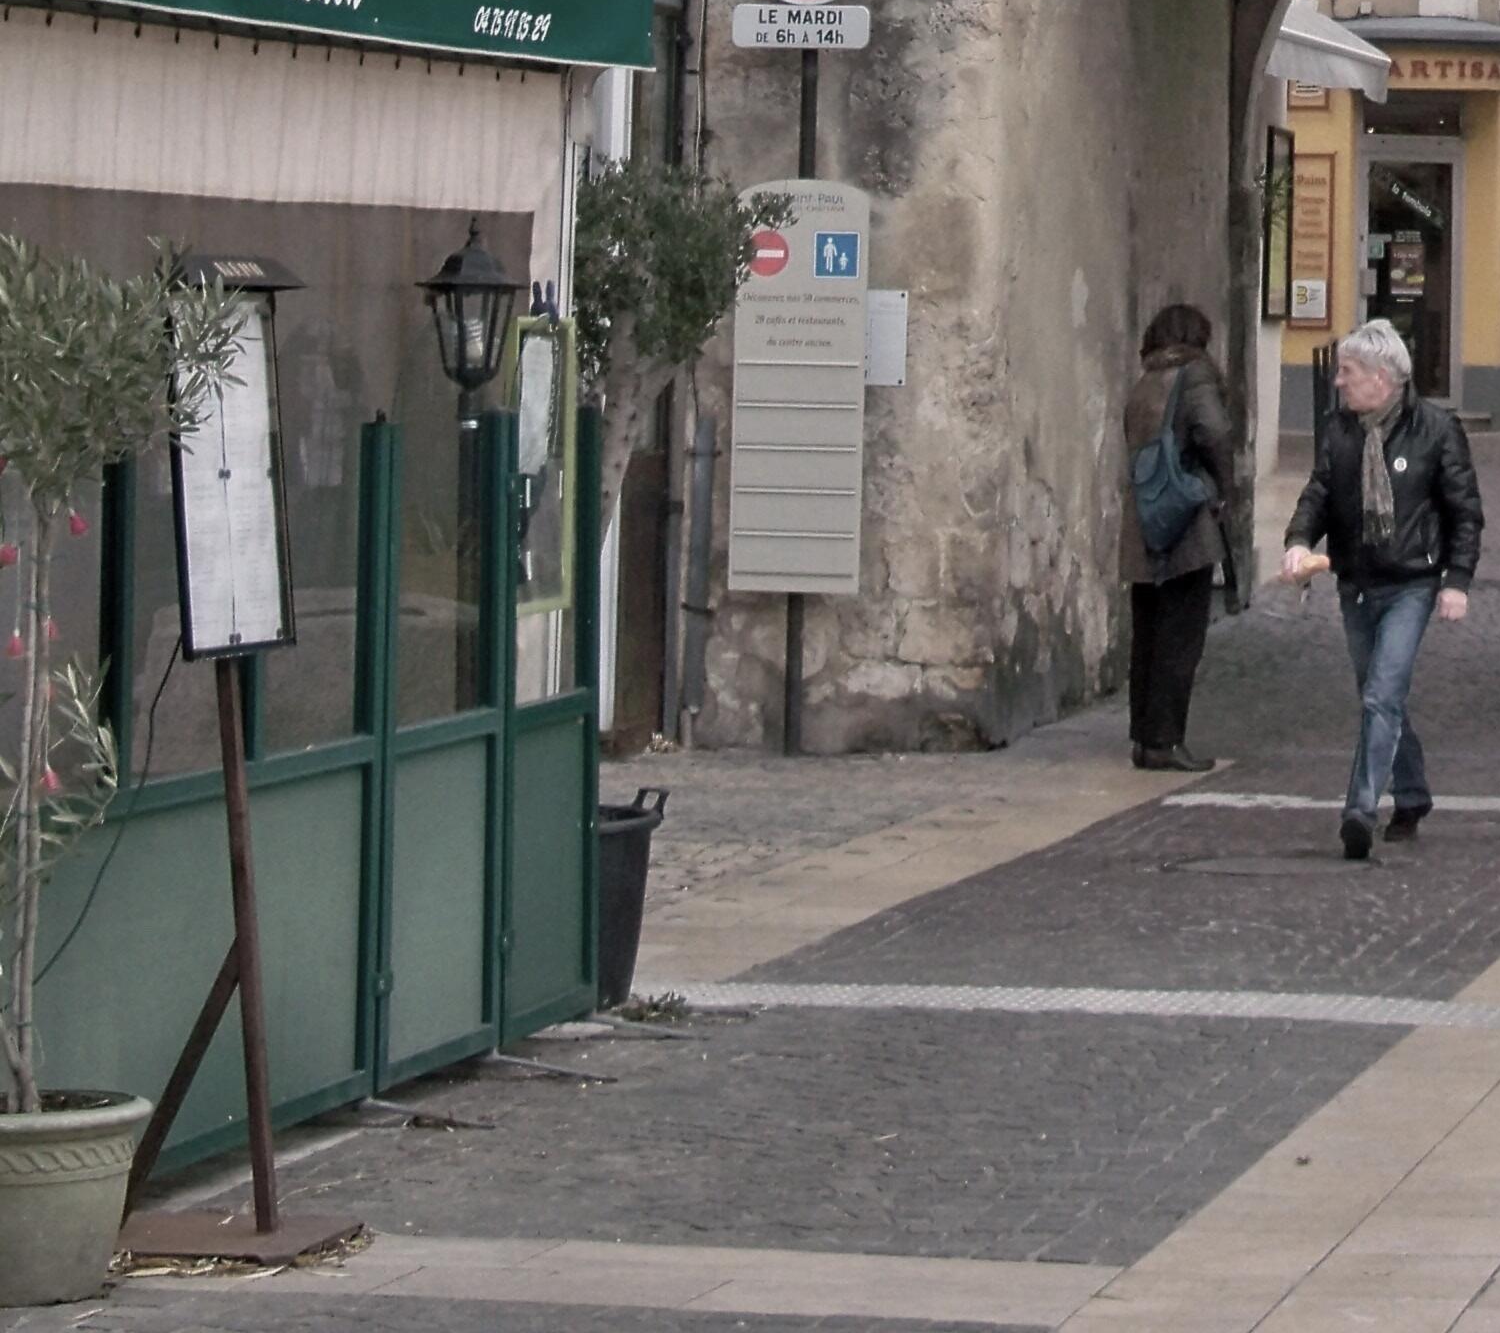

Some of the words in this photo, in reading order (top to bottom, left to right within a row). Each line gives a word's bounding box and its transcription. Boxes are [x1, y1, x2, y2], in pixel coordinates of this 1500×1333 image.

[758, 9, 778, 24] LE
[787, 10, 842, 25] MARDI
[756, 32, 768, 43] DE
[776, 29, 796, 44] 6h
[817, 29, 844, 44] 14h
